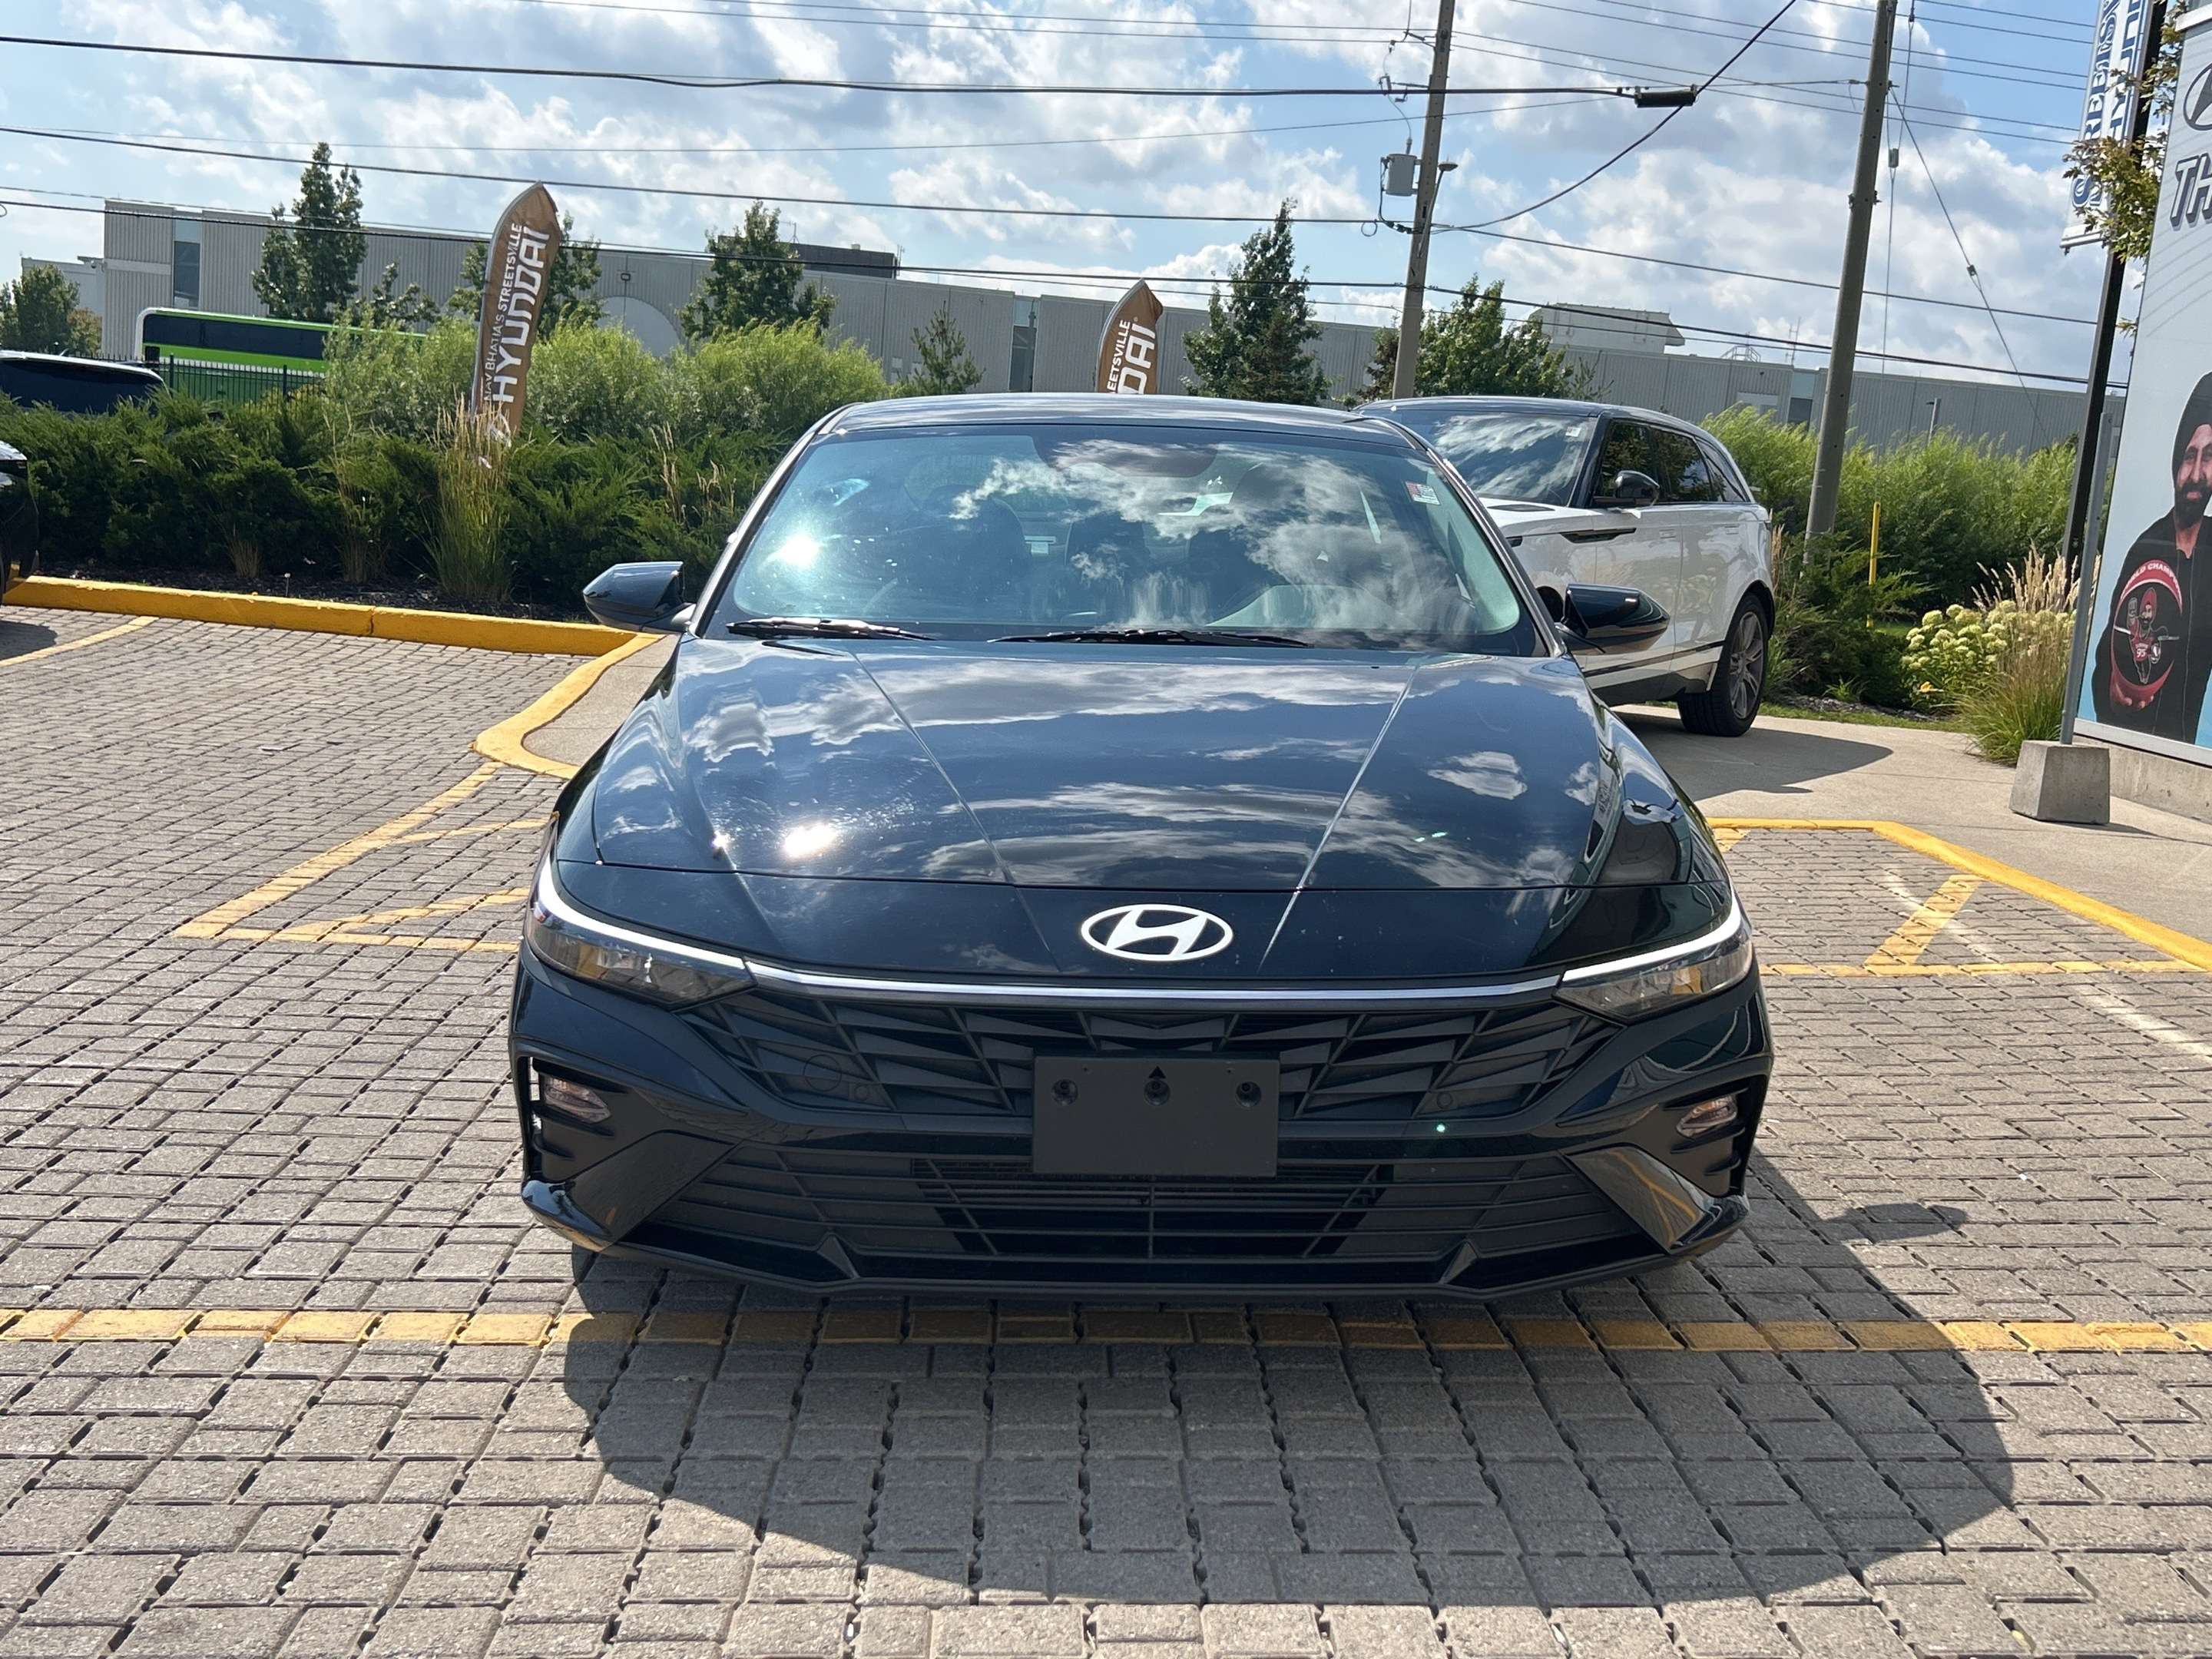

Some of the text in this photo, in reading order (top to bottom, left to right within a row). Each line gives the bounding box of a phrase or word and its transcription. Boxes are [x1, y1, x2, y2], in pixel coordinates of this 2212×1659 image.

[485, 313, 505, 370] BHATIA'S
[498, 222, 523, 312] STREETSVILLE
[492, 226, 551, 403] HYUNDAI
[1107, 320, 1131, 394] EETSVILLE
